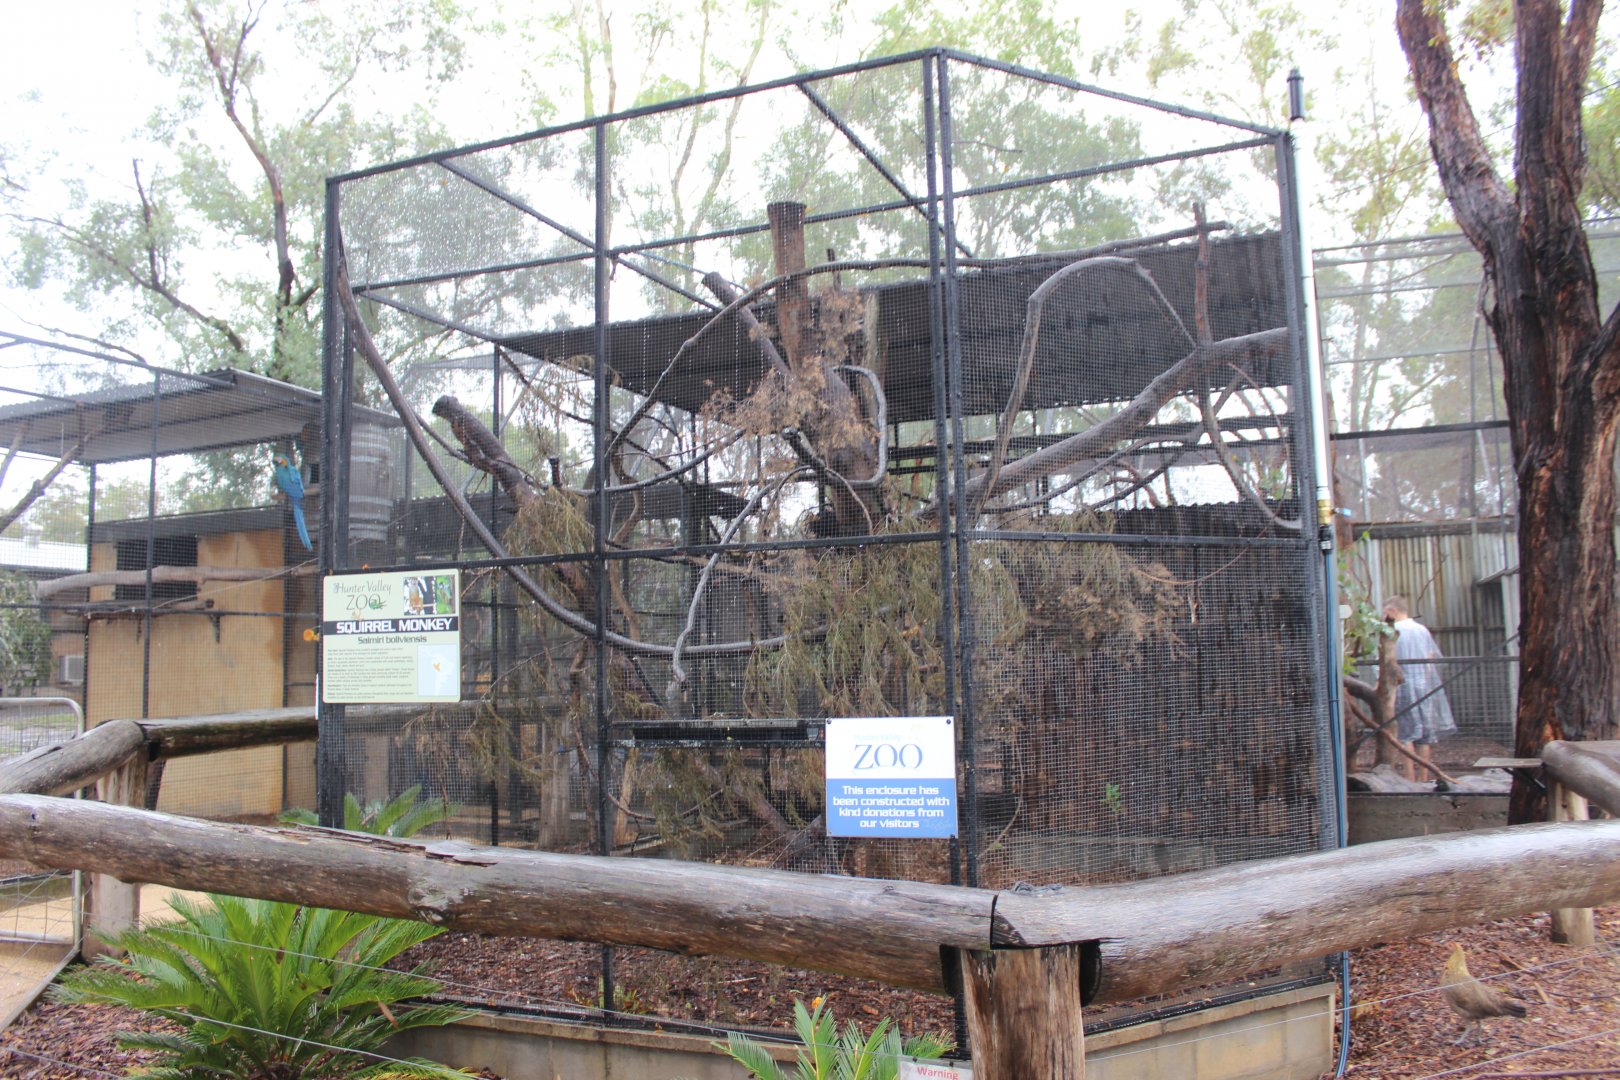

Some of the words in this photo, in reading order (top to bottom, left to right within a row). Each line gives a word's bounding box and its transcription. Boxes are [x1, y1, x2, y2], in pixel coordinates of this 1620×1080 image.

[335, 582, 365, 594] Hunter
[366, 580, 392, 596] Valley
[346, 594, 381, 611] ZOO
[336, 620, 396, 634] SQUIRREL
[399, 618, 452, 631] MONKEY
[358, 636, 385, 644] Saimiri
[385, 635, 427, 644] boliviensis
[854, 743, 923, 769] ZOO
[843, 785, 864, 795] This
[865, 786, 917, 795] enclosure
[919, 786, 939, 795] has
[833, 797, 858, 806] been
[860, 797, 924, 806] constructed
[926, 797, 950, 806] with
[839, 808, 861, 817] kind
[863, 808, 916, 817] donations
[918, 808, 944, 817] from
[860, 820, 877, 828] our
[879, 819, 920, 828] visitors
[917, 1066, 959, 1080] Warning
